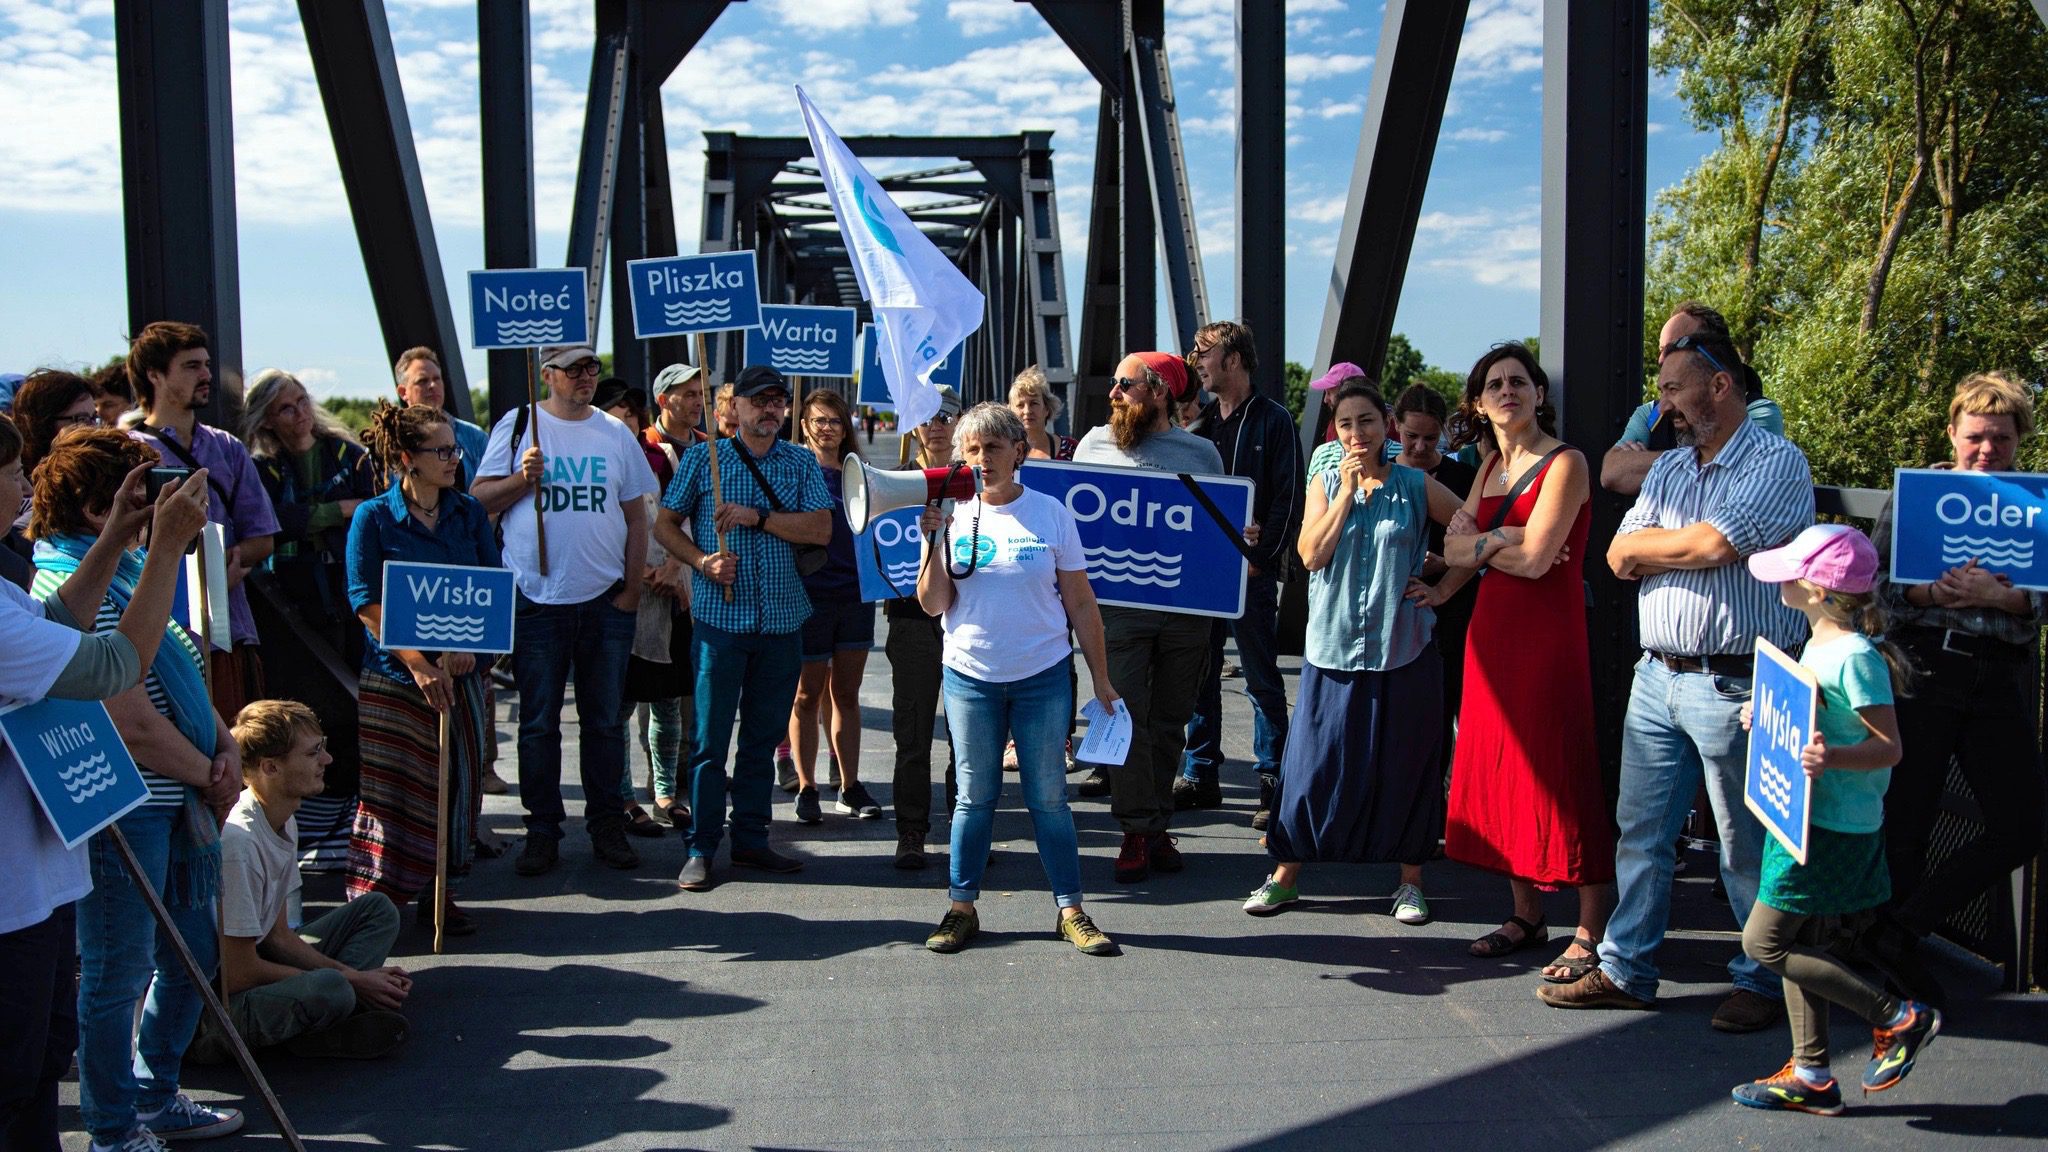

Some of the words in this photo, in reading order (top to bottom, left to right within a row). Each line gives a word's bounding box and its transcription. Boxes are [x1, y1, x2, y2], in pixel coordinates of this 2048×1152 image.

[648, 262, 744, 296] Pliszka
[484, 284, 571, 313] Noteć
[760, 318, 837, 344] Warta
[534, 485, 607, 514] ODER
[1065, 483, 1193, 532] Odra
[1936, 492, 2042, 528] Oder
[406, 574, 493, 607] Wisła
[1758, 682, 1801, 762] Myśla
